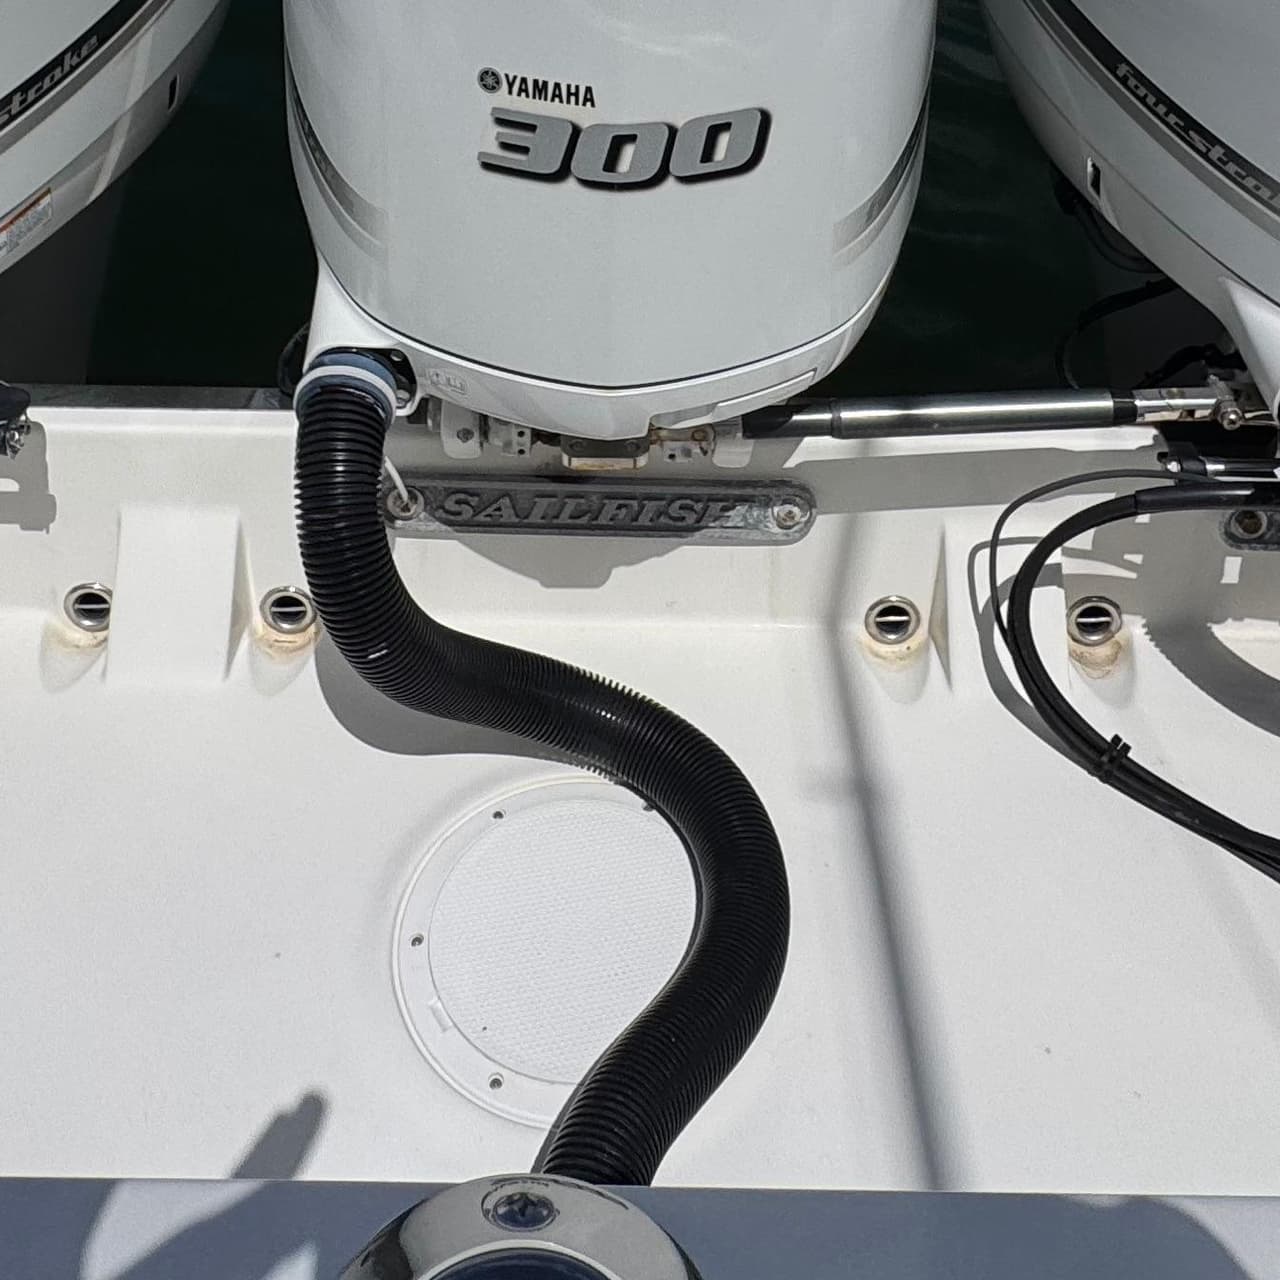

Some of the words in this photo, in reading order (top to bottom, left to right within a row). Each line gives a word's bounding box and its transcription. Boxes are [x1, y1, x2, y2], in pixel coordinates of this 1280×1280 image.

[504, 73, 597, 108] YAMAHA
[477, 106, 772, 190] 300
[438, 490, 754, 528] SAILFISH
